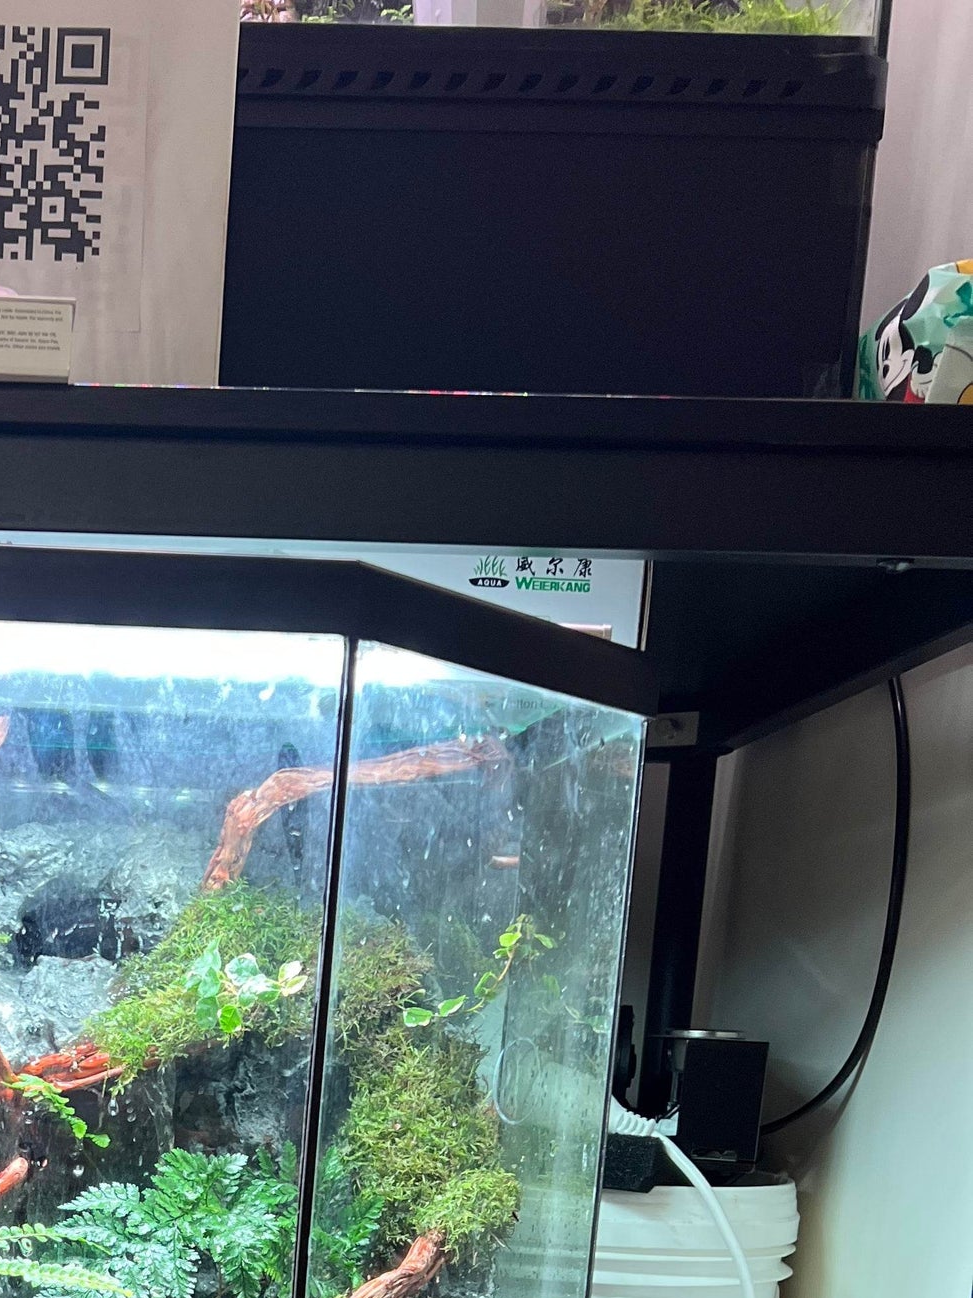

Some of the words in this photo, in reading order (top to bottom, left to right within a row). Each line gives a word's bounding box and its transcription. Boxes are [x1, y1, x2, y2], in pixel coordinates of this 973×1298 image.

[516, 557, 592, 578] 威尔康
[477, 578, 502, 587] AQUA
[515, 576, 591, 593] WEIERKANG
